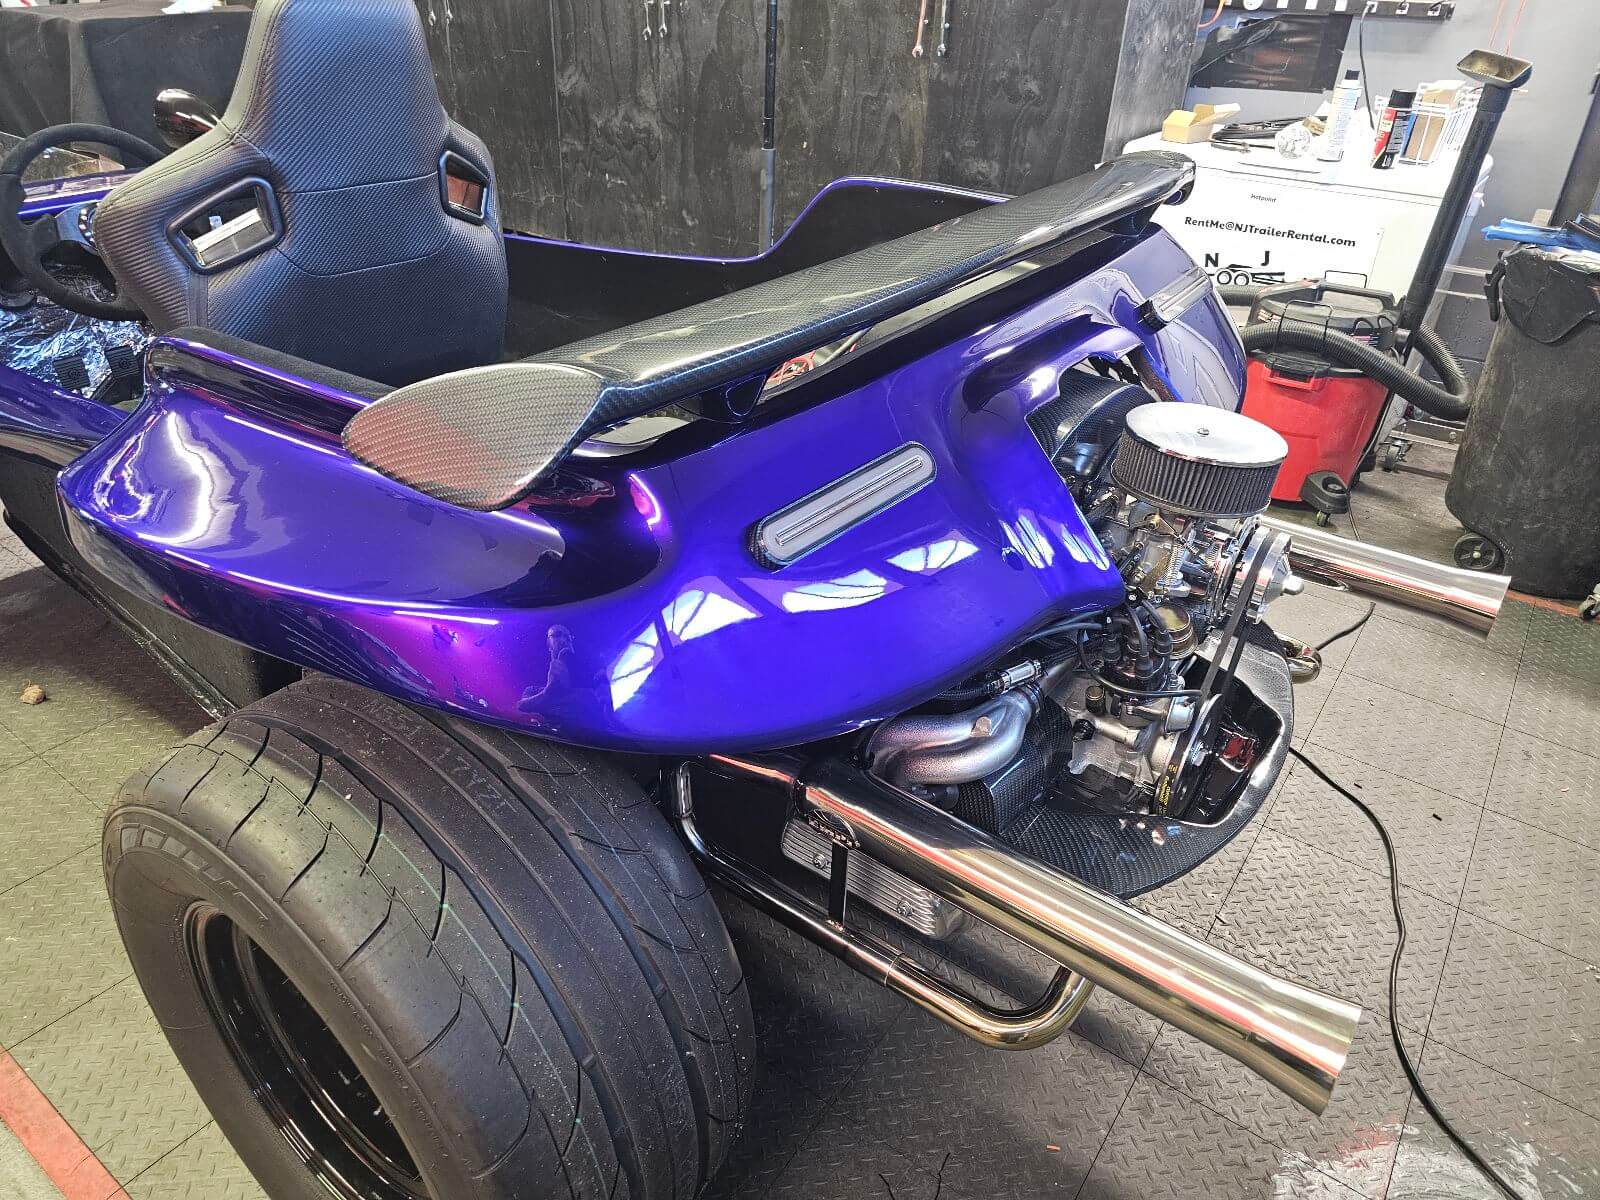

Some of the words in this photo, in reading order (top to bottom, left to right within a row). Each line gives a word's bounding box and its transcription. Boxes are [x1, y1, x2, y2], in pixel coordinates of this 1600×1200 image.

[1184, 216, 1356, 247] RentMe@NJTrailerRental.com
[1204, 252, 1219, 268] N
[1260, 250, 1271, 266] J
